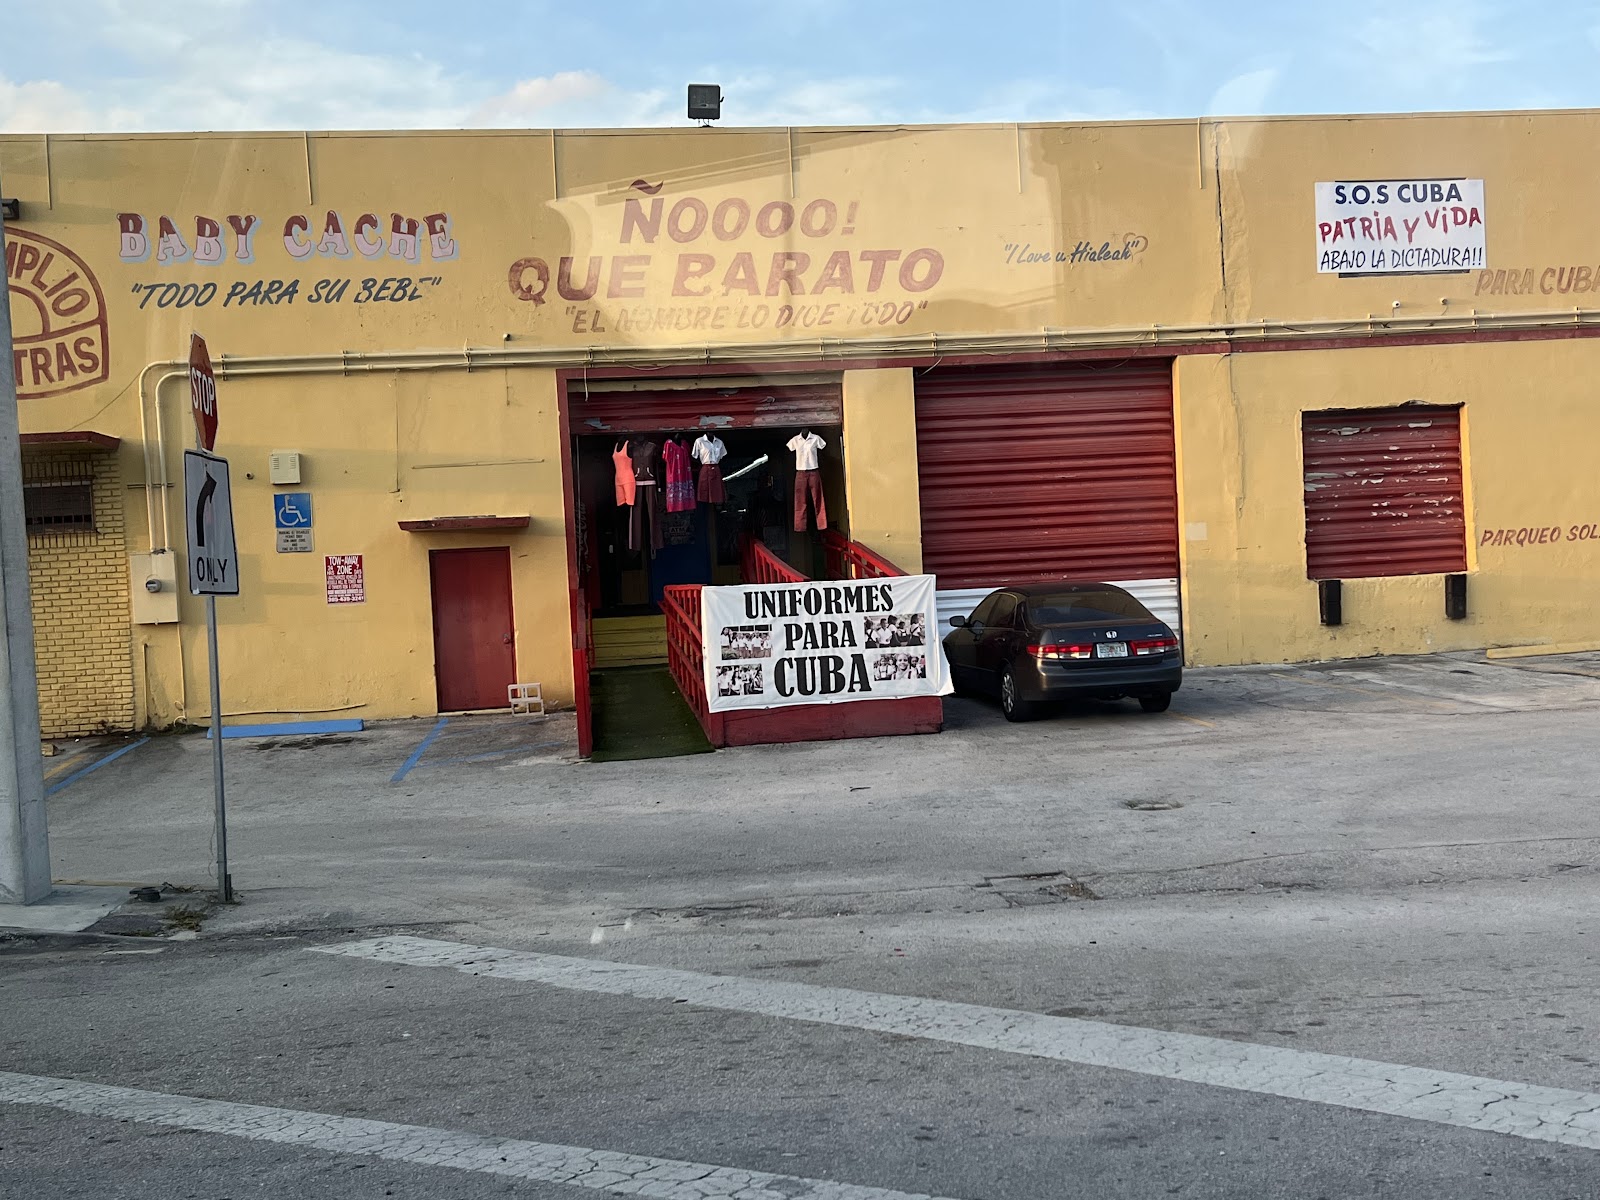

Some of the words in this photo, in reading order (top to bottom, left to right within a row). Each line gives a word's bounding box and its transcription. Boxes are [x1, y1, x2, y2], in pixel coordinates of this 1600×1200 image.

[1335, 185, 1390, 205] S.O.S
[1397, 183, 1463, 203] CUBA
[620, 179, 860, 243] ÑOOOO!
[116, 212, 260, 265] BABY
[283, 210, 457, 264] CACHE
[1017, 243, 1051, 264] Love
[1320, 250, 1366, 270] ABAJO
[1371, 249, 1386, 269] LA
[1391, 247, 1482, 269] DICTADURA!!
[5, 241, 91, 317] MPLIO
[508, 255, 652, 307] QUE
[671, 247, 945, 297] BARATO
[1475, 267, 1535, 296] PARA
[131, 281, 218, 309] "TODO
[223, 279, 300, 308] PARA
[308, 278, 351, 303] SU
[565, 306, 605, 333] "EL
[615, 305, 727, 333] NOMBRE
[736, 303, 770, 329] LO
[775, 303, 841, 328] DICE
[14, 336, 100, 387] TRAS
[191, 366, 215, 417] STOP
[1480, 526, 1561, 547] PARQUEO
[1566, 523, 1600, 541] SOL
[197, 556, 228, 583] ONLY
[328, 556, 359, 566] TOW-AWAY
[337, 564, 353, 575] ZONE
[743, 584, 894, 620] UNIFORMES
[784, 620, 858, 651] PARA
[774, 654, 872, 697] CUBA
